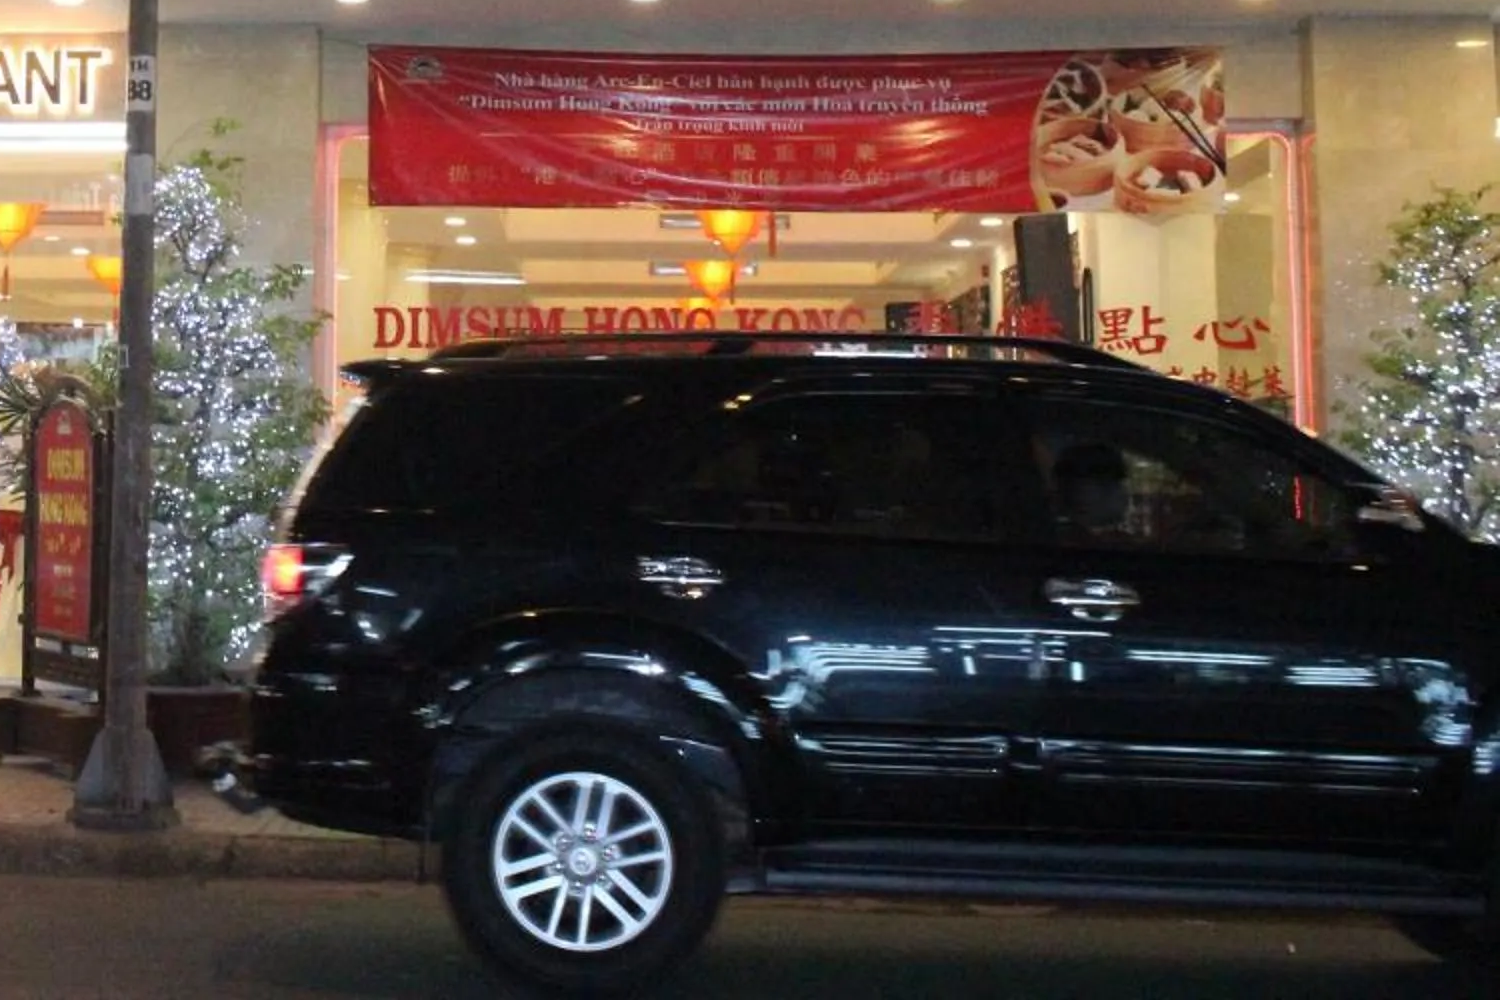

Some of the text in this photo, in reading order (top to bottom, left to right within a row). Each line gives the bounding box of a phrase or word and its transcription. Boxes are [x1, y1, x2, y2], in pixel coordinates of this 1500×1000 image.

[373, 306, 867, 349] DIMSUM HONG KONG
